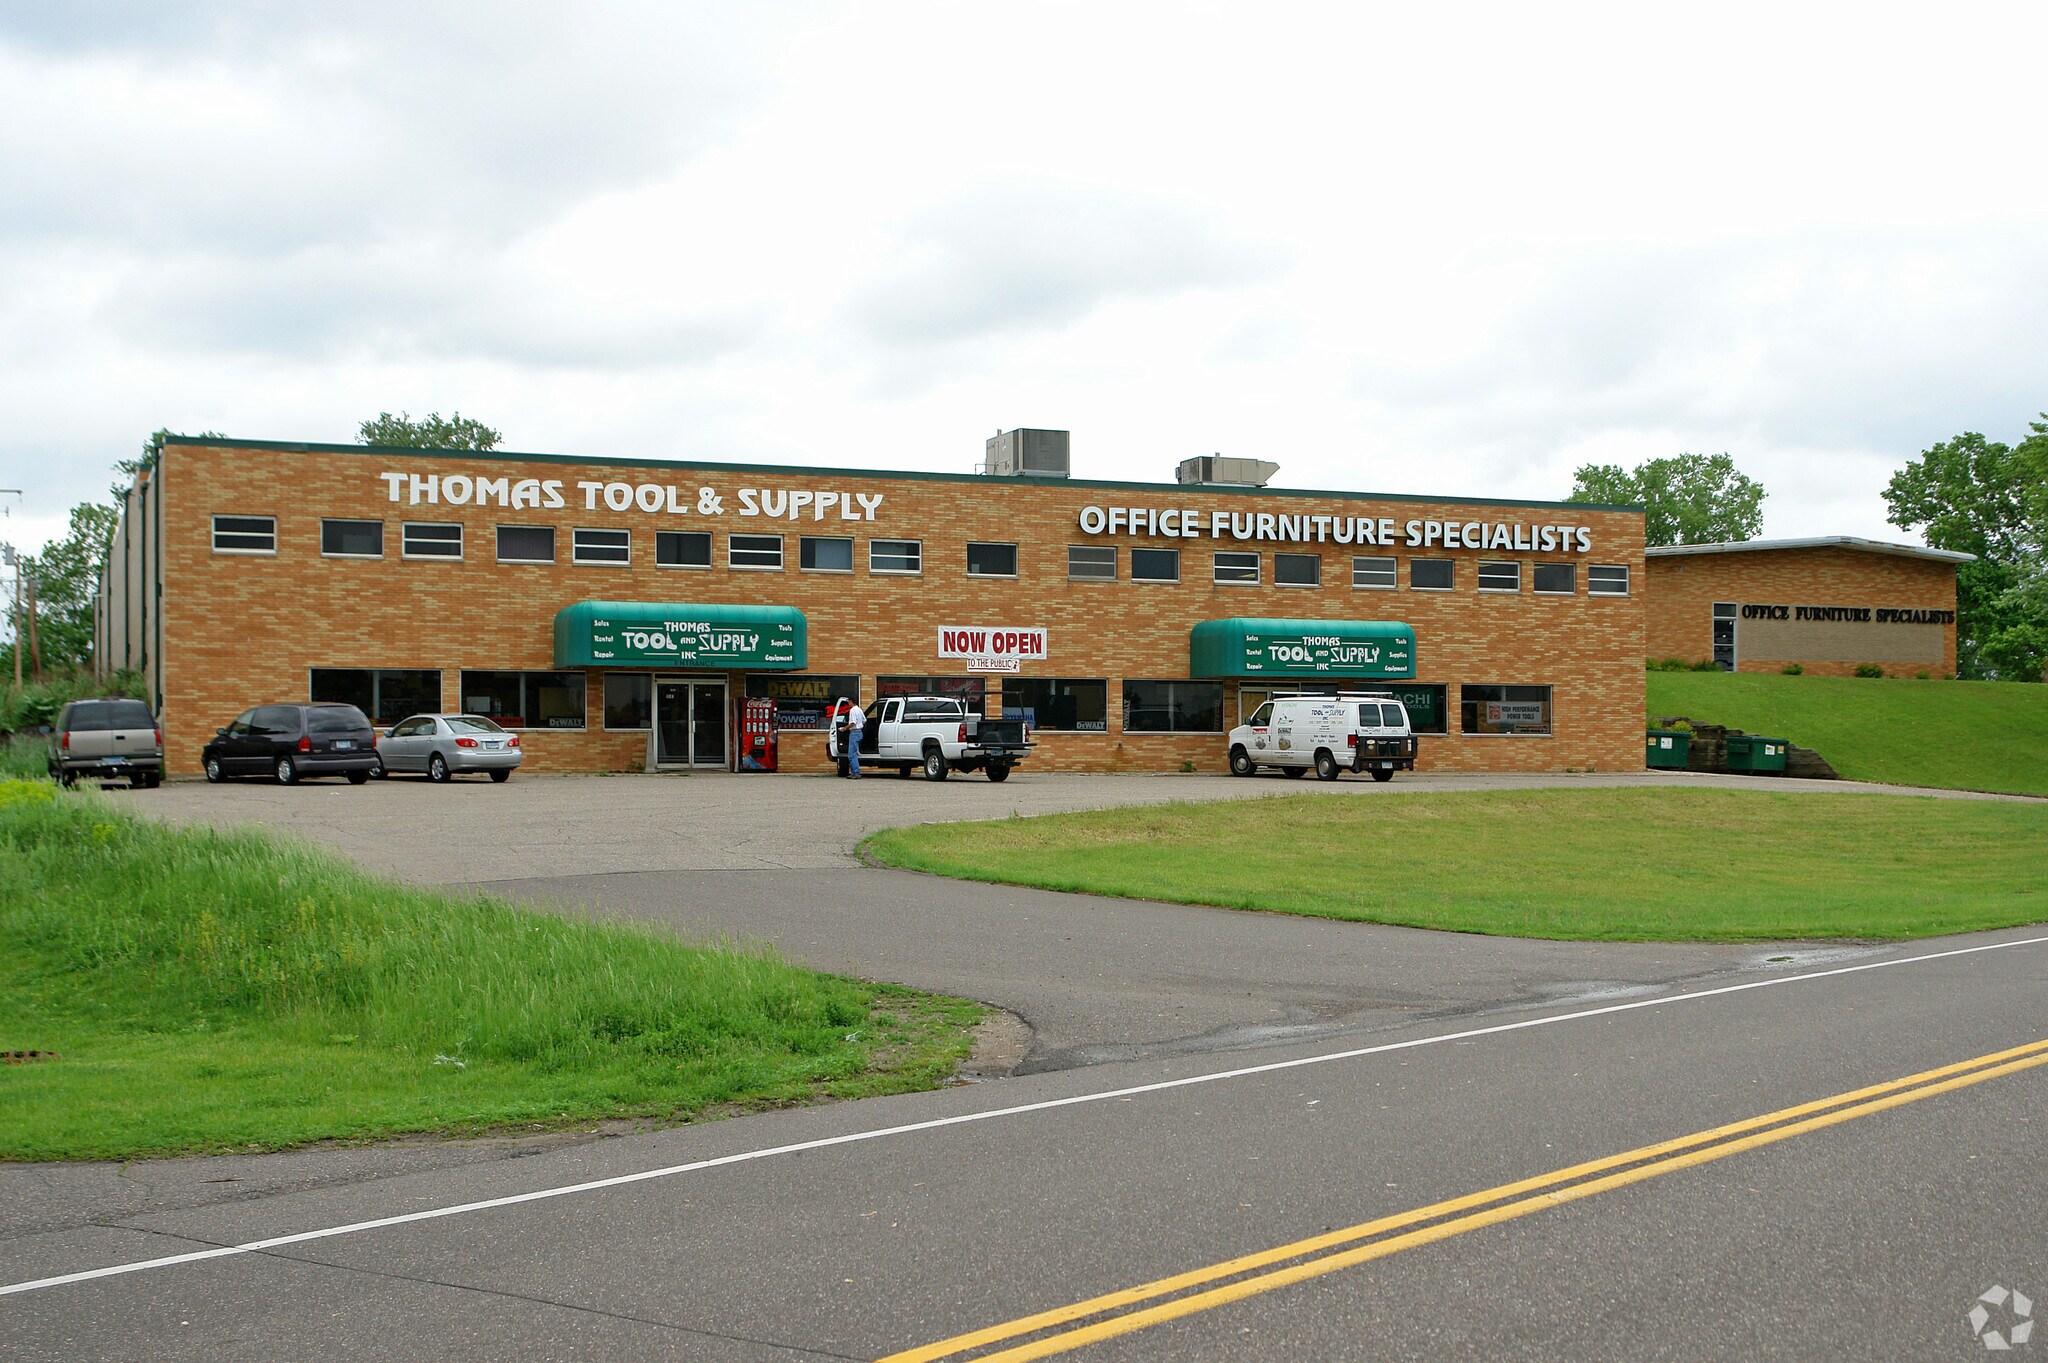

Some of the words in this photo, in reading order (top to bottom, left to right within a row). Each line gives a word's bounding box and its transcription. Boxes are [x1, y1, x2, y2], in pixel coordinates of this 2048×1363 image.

[380, 472, 566, 511] THOMAS
[577, 480, 688, 514] TOOL
[697, 486, 725, 515] &
[738, 488, 884, 521] SUPPLY
[1078, 505, 1200, 538] OFFICE
[1211, 511, 1395, 546] FURNITURE
[1405, 518, 1592, 553] SPECIALISTS
[1741, 605, 1790, 620] OFFICE
[1795, 606, 1871, 622] FURNITURE
[1876, 608, 1955, 625] SPECIALISTS
[594, 619, 610, 627] Sales
[664, 621, 711, 633] THOMAS
[778, 624, 793, 632] Tools
[594, 635, 614, 643] Rental
[621, 632, 678, 650] TOOL
[698, 633, 760, 652] SUPPLY
[770, 639, 793, 647] Supplies
[943, 631, 986, 653] NOW
[992, 632, 1042, 654] OPEN
[1302, 636, 1341, 647] THOMAS
[594, 651, 614, 659] Repair
[681, 651, 697, 660] INC
[1268, 646, 1314, 662] TOOL
[1330, 646, 1380, 664] SUPPLY
[968, 659, 976, 667] TO
[977, 659, 988, 667] THE
[990, 660, 1012, 668] PUBLIC
[1316, 663, 1330, 671] INC
